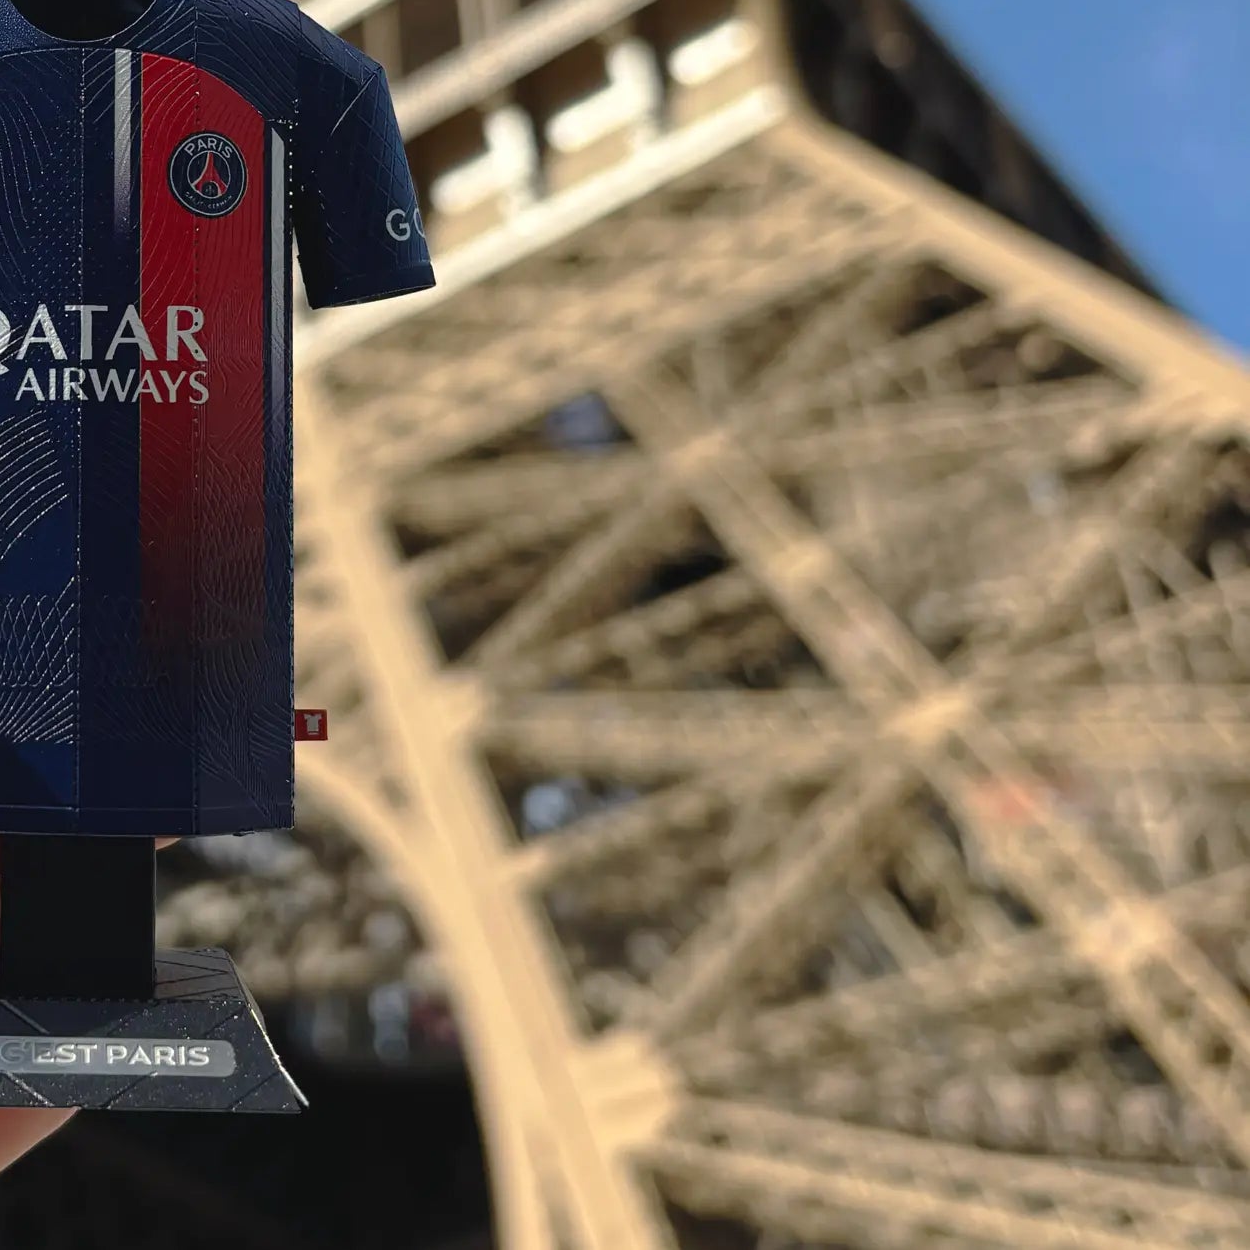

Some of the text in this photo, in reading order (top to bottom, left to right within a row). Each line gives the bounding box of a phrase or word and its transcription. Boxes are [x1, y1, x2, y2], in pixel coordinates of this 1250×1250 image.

[184, 137, 232, 158] PARIS
[15, 367, 209, 405] AIRWAYS
[106, 1045, 210, 1066] PARIS
